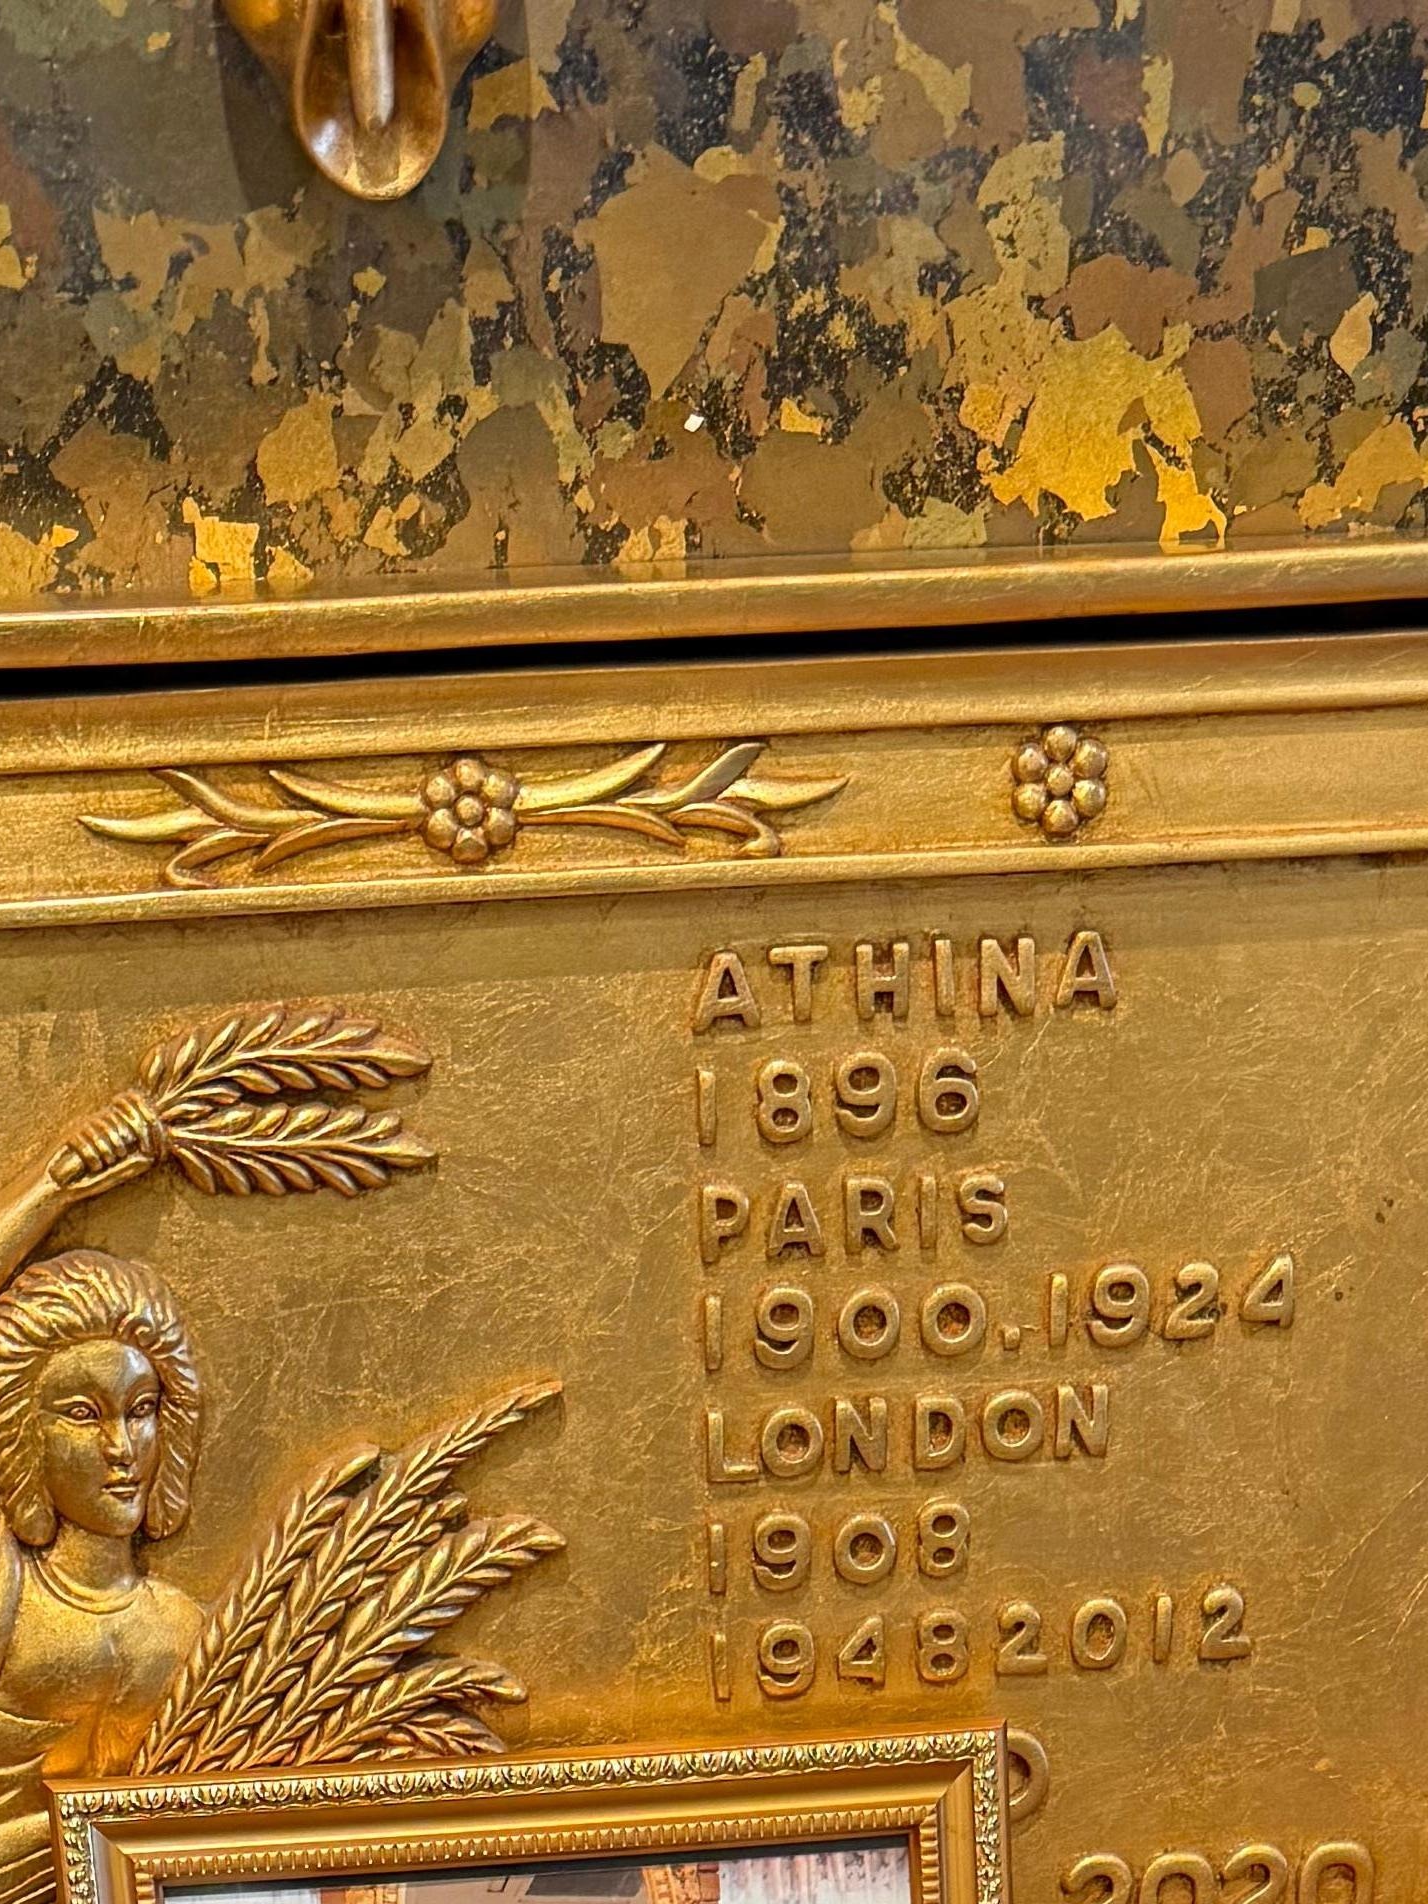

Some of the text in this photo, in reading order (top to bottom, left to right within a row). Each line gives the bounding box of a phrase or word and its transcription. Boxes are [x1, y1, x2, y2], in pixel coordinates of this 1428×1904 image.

[691, 929, 1120, 1033] ATHINA
[695, 1046, 981, 1147] 1896
[700, 1171, 1010, 1265] PARIS
[705, 1383, 1110, 1485] LONDON
[706, 1497, 972, 1597] 1908
